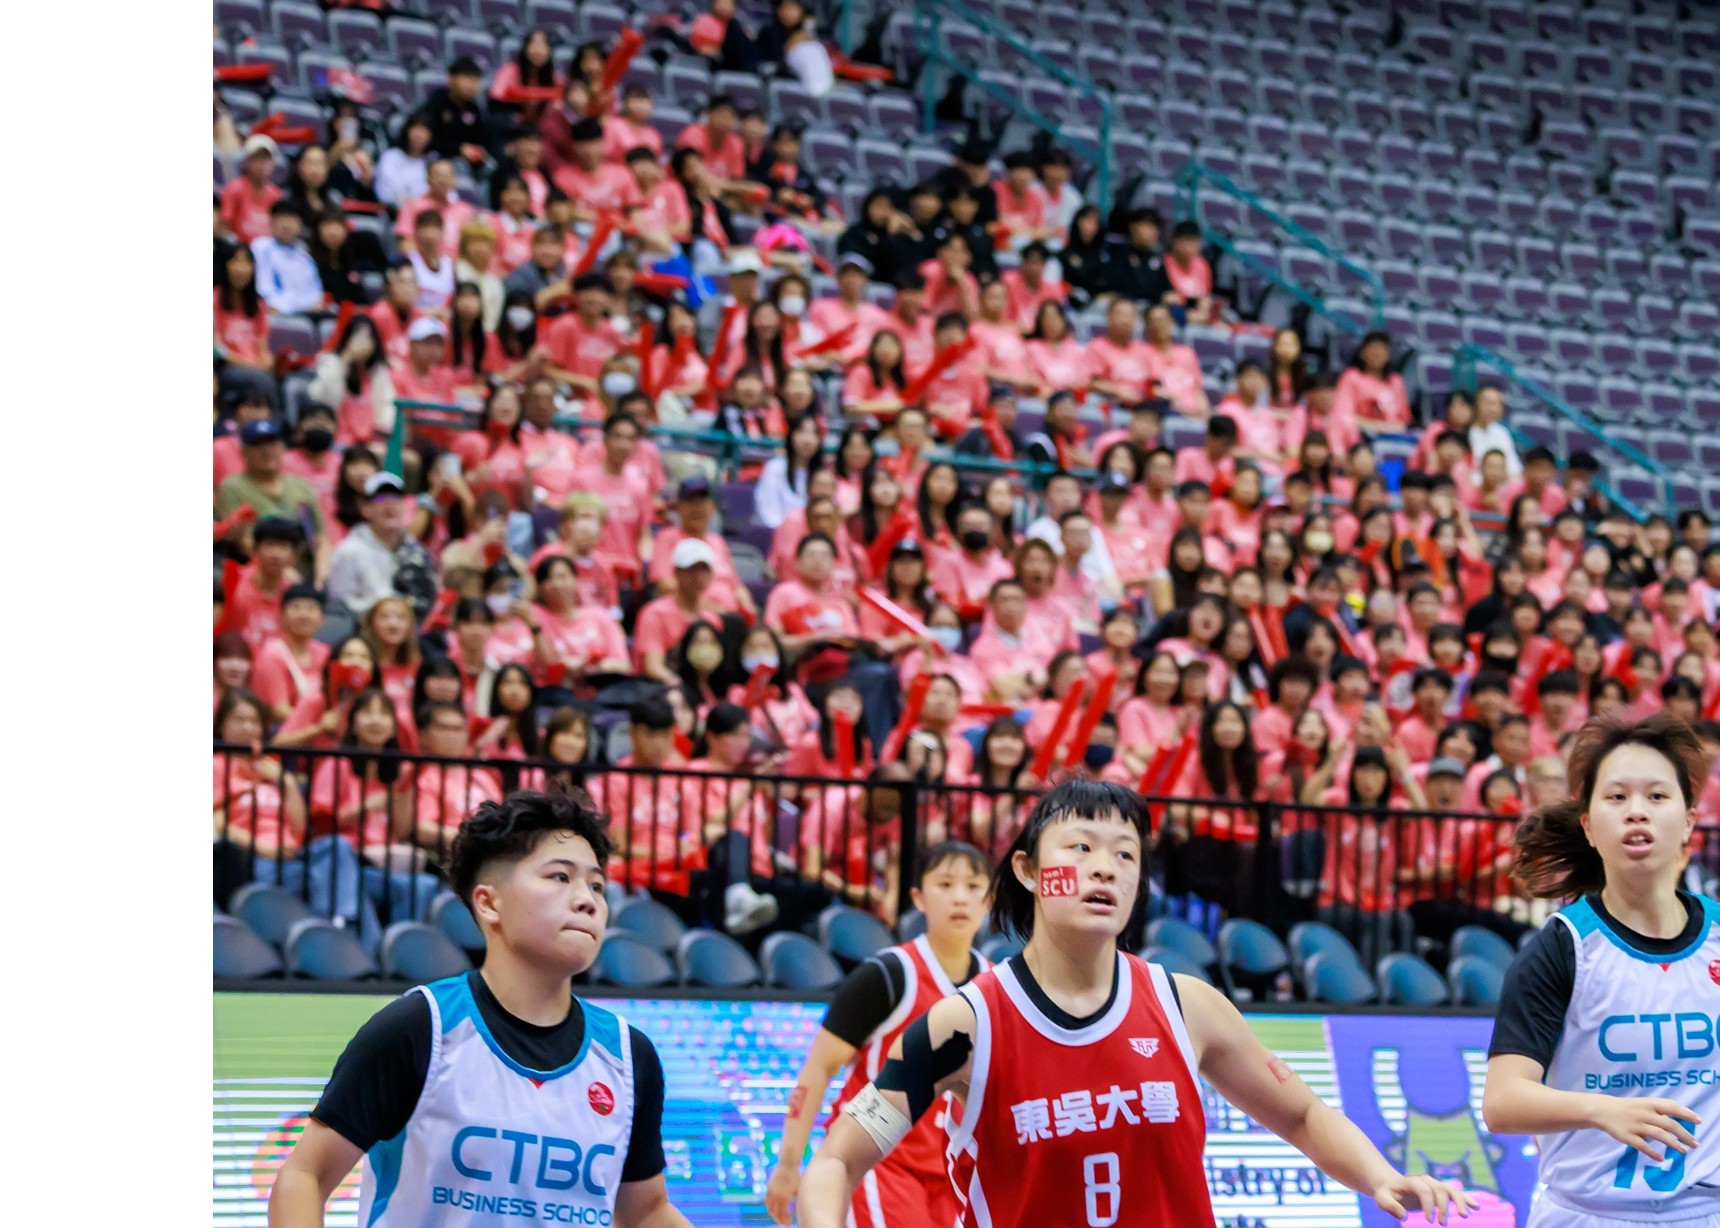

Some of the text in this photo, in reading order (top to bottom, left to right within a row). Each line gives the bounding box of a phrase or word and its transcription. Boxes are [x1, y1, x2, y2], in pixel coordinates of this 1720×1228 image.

[1042, 879, 1075, 896] SCU
[1585, 1070, 1682, 1090] BUSINESS
[1010, 1081, 1180, 1145] 東吳大學
[451, 1125, 616, 1197] CTBC
[1207, 1156, 1285, 1205] istry
[432, 1186, 613, 1227] BUSINESS SCHOO
[1083, 1151, 1121, 1228] 8
